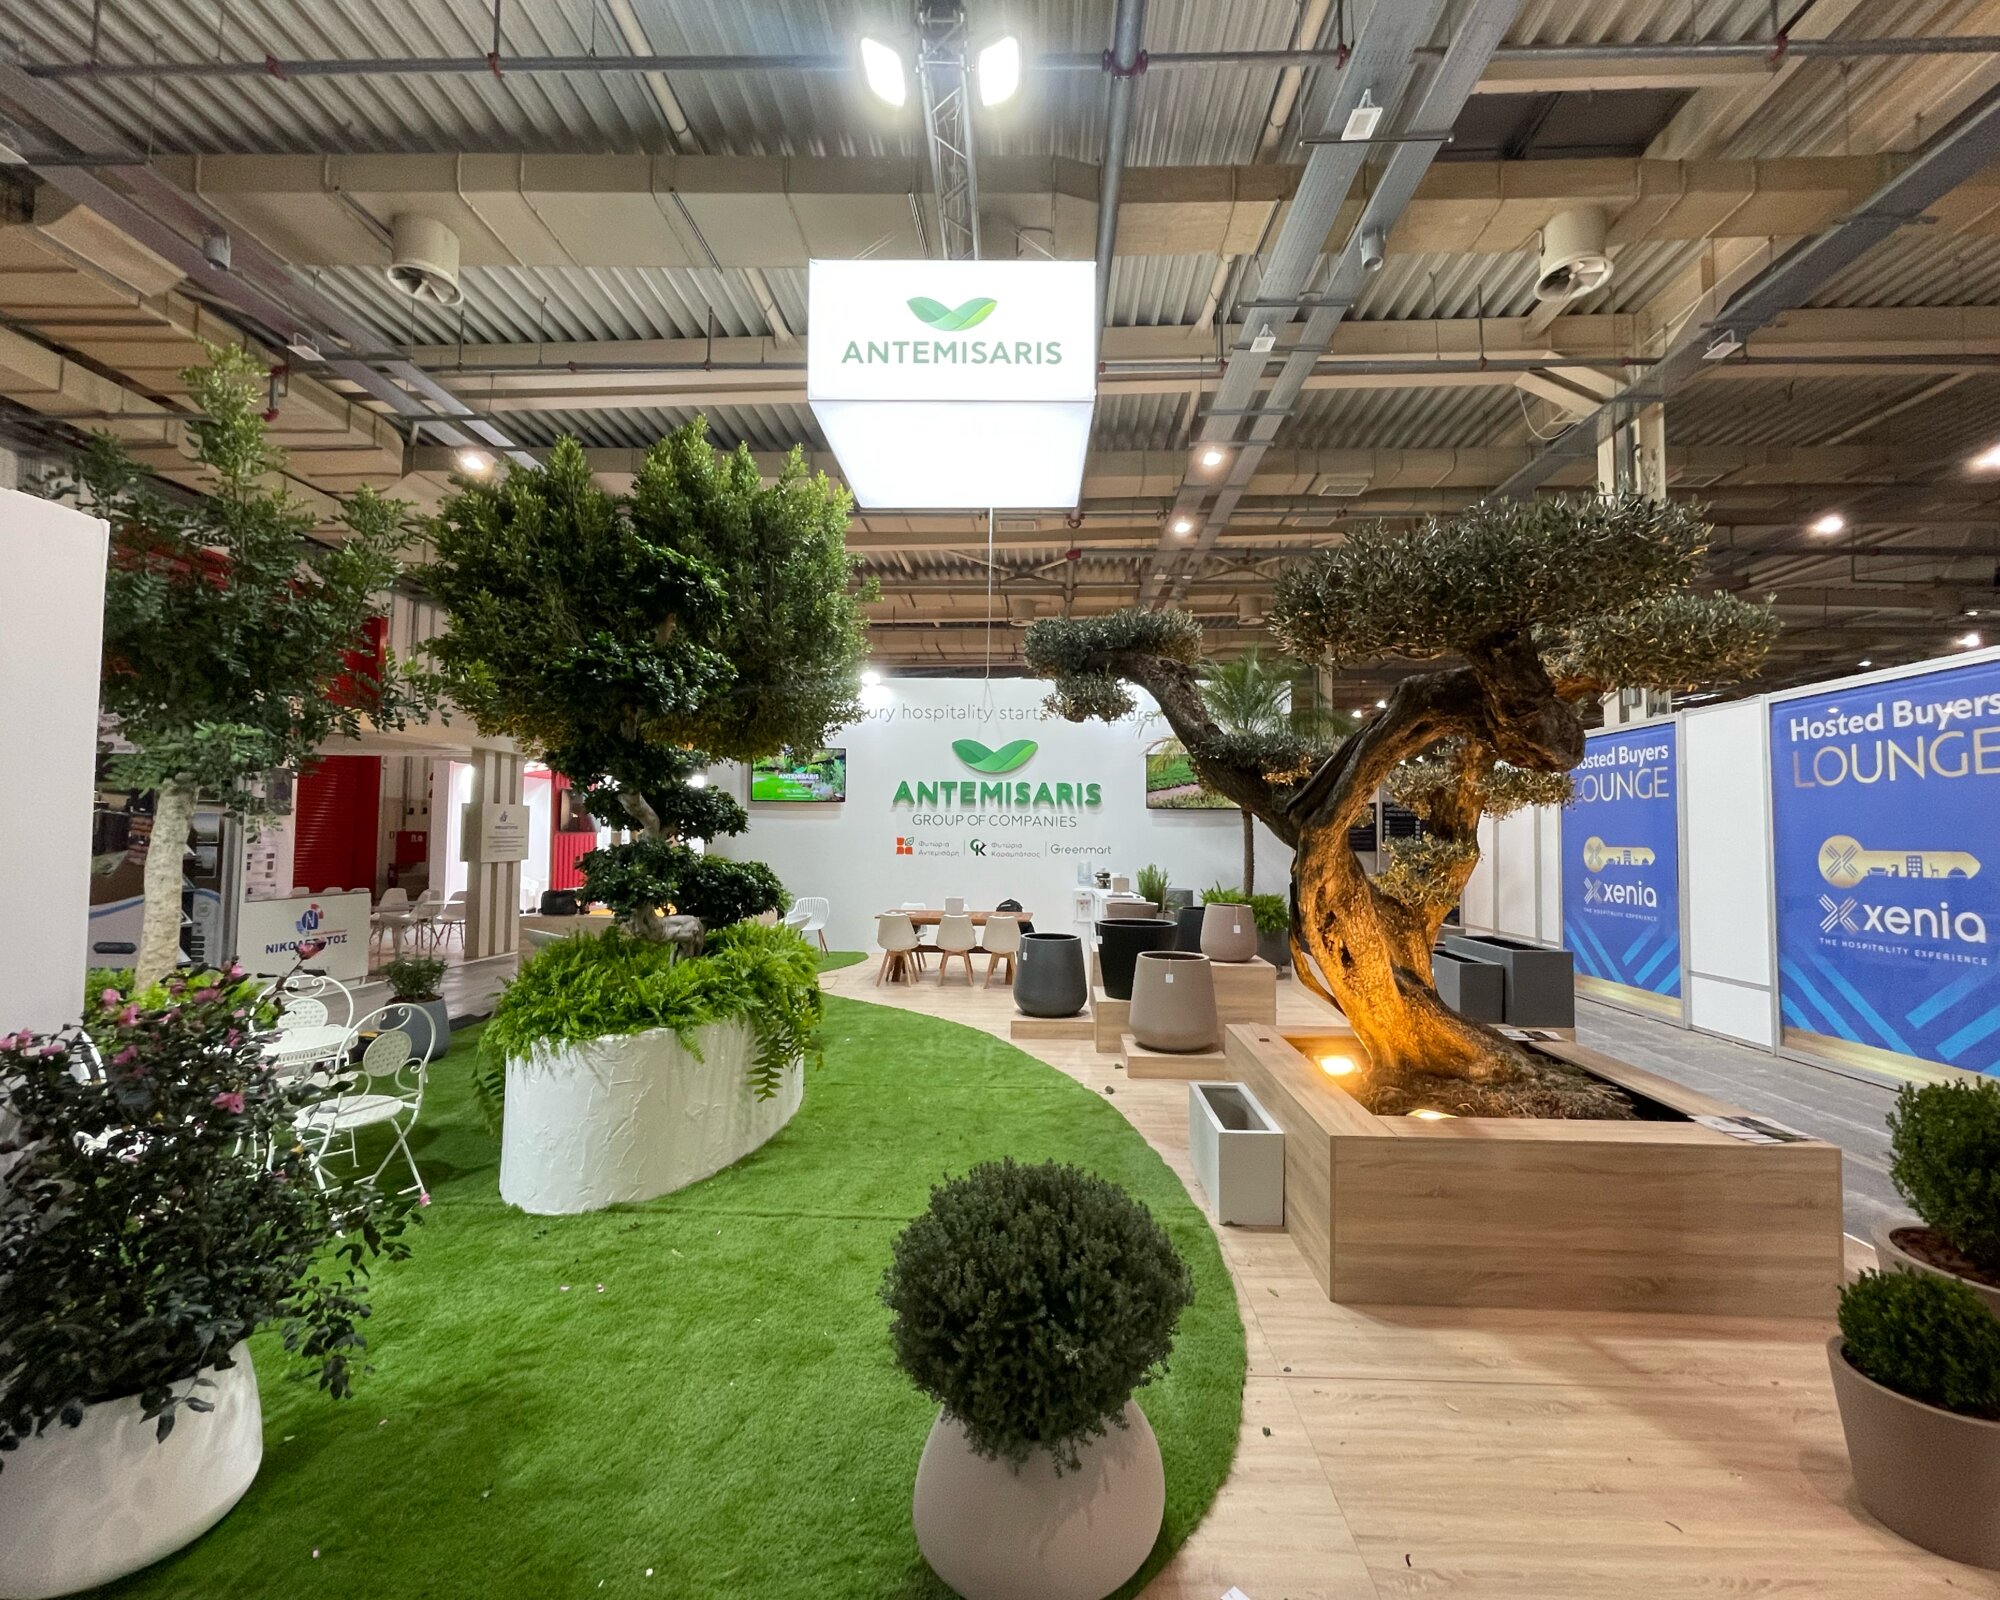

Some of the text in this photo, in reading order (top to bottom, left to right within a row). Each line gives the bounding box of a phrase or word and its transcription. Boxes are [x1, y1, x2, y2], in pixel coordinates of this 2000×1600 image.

[842, 340, 1062, 364] ANTEMISARIS
[902, 703, 993, 723] hospitality
[1790, 693, 2000, 742] Hosted Buyers
[1577, 744, 1669, 769] osted Buyers
[1792, 726, 2000, 788] LOUNGE
[892, 780, 1103, 807] ANTEMISARIS
[1580, 766, 1670, 802] OUNGE
[912, 814, 1077, 828] GROUP OF COMPANIES
[1050, 843, 1112, 855] Greenmart
[1603, 881, 1657, 908] xenia
[1862, 901, 1987, 944] xenia
[1819, 937, 1988, 966] THE HOSPITALITY EXPERIENCE
